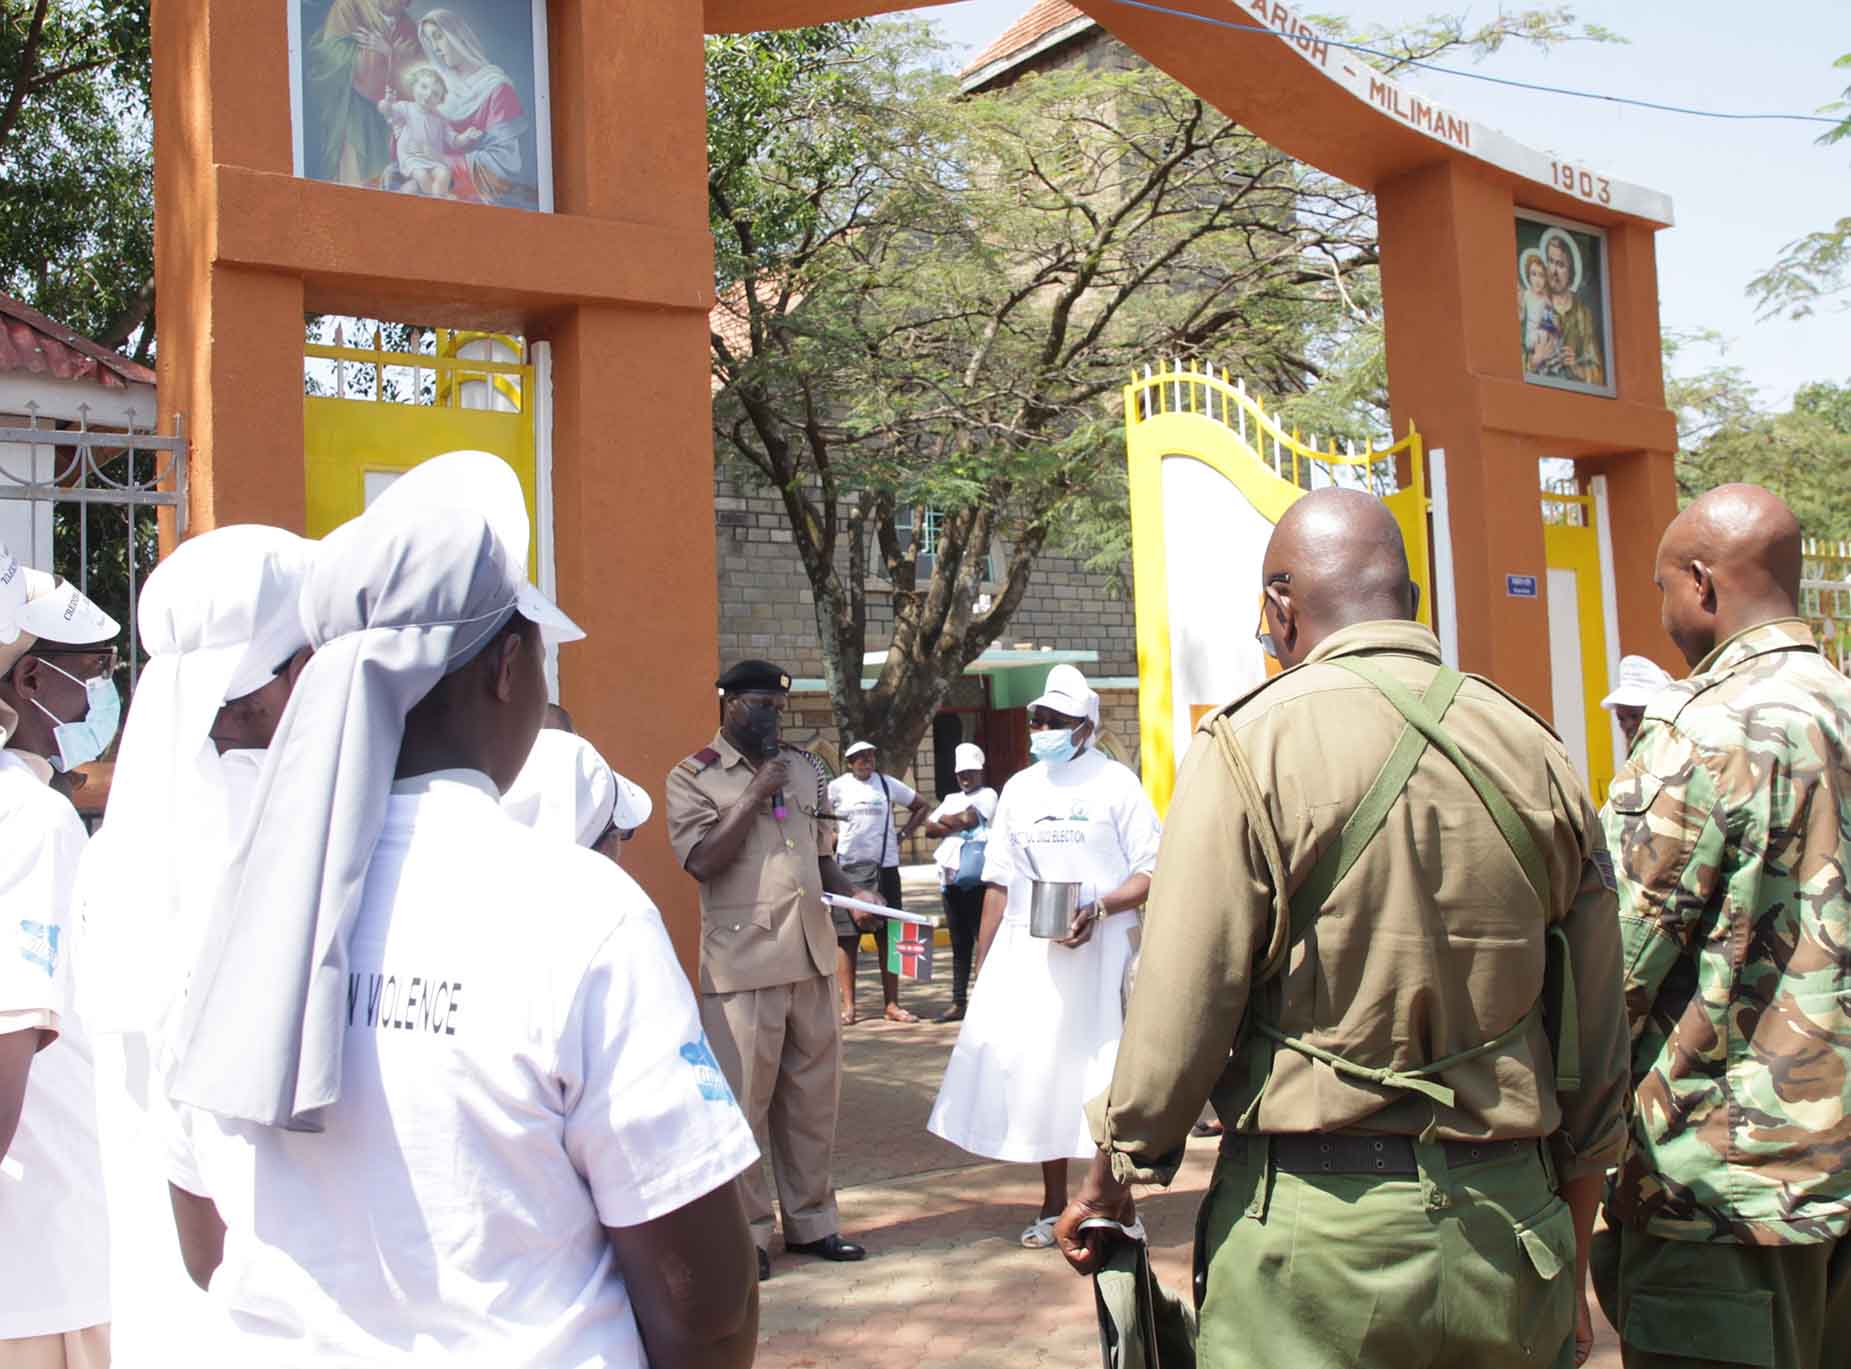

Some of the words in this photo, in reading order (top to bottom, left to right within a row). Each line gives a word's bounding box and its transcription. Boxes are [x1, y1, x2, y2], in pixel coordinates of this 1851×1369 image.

[1369, 76, 1471, 148] MILIMANI
[1551, 161, 1611, 205] 1903
[367, 973, 462, 1035] VIOLENCE
